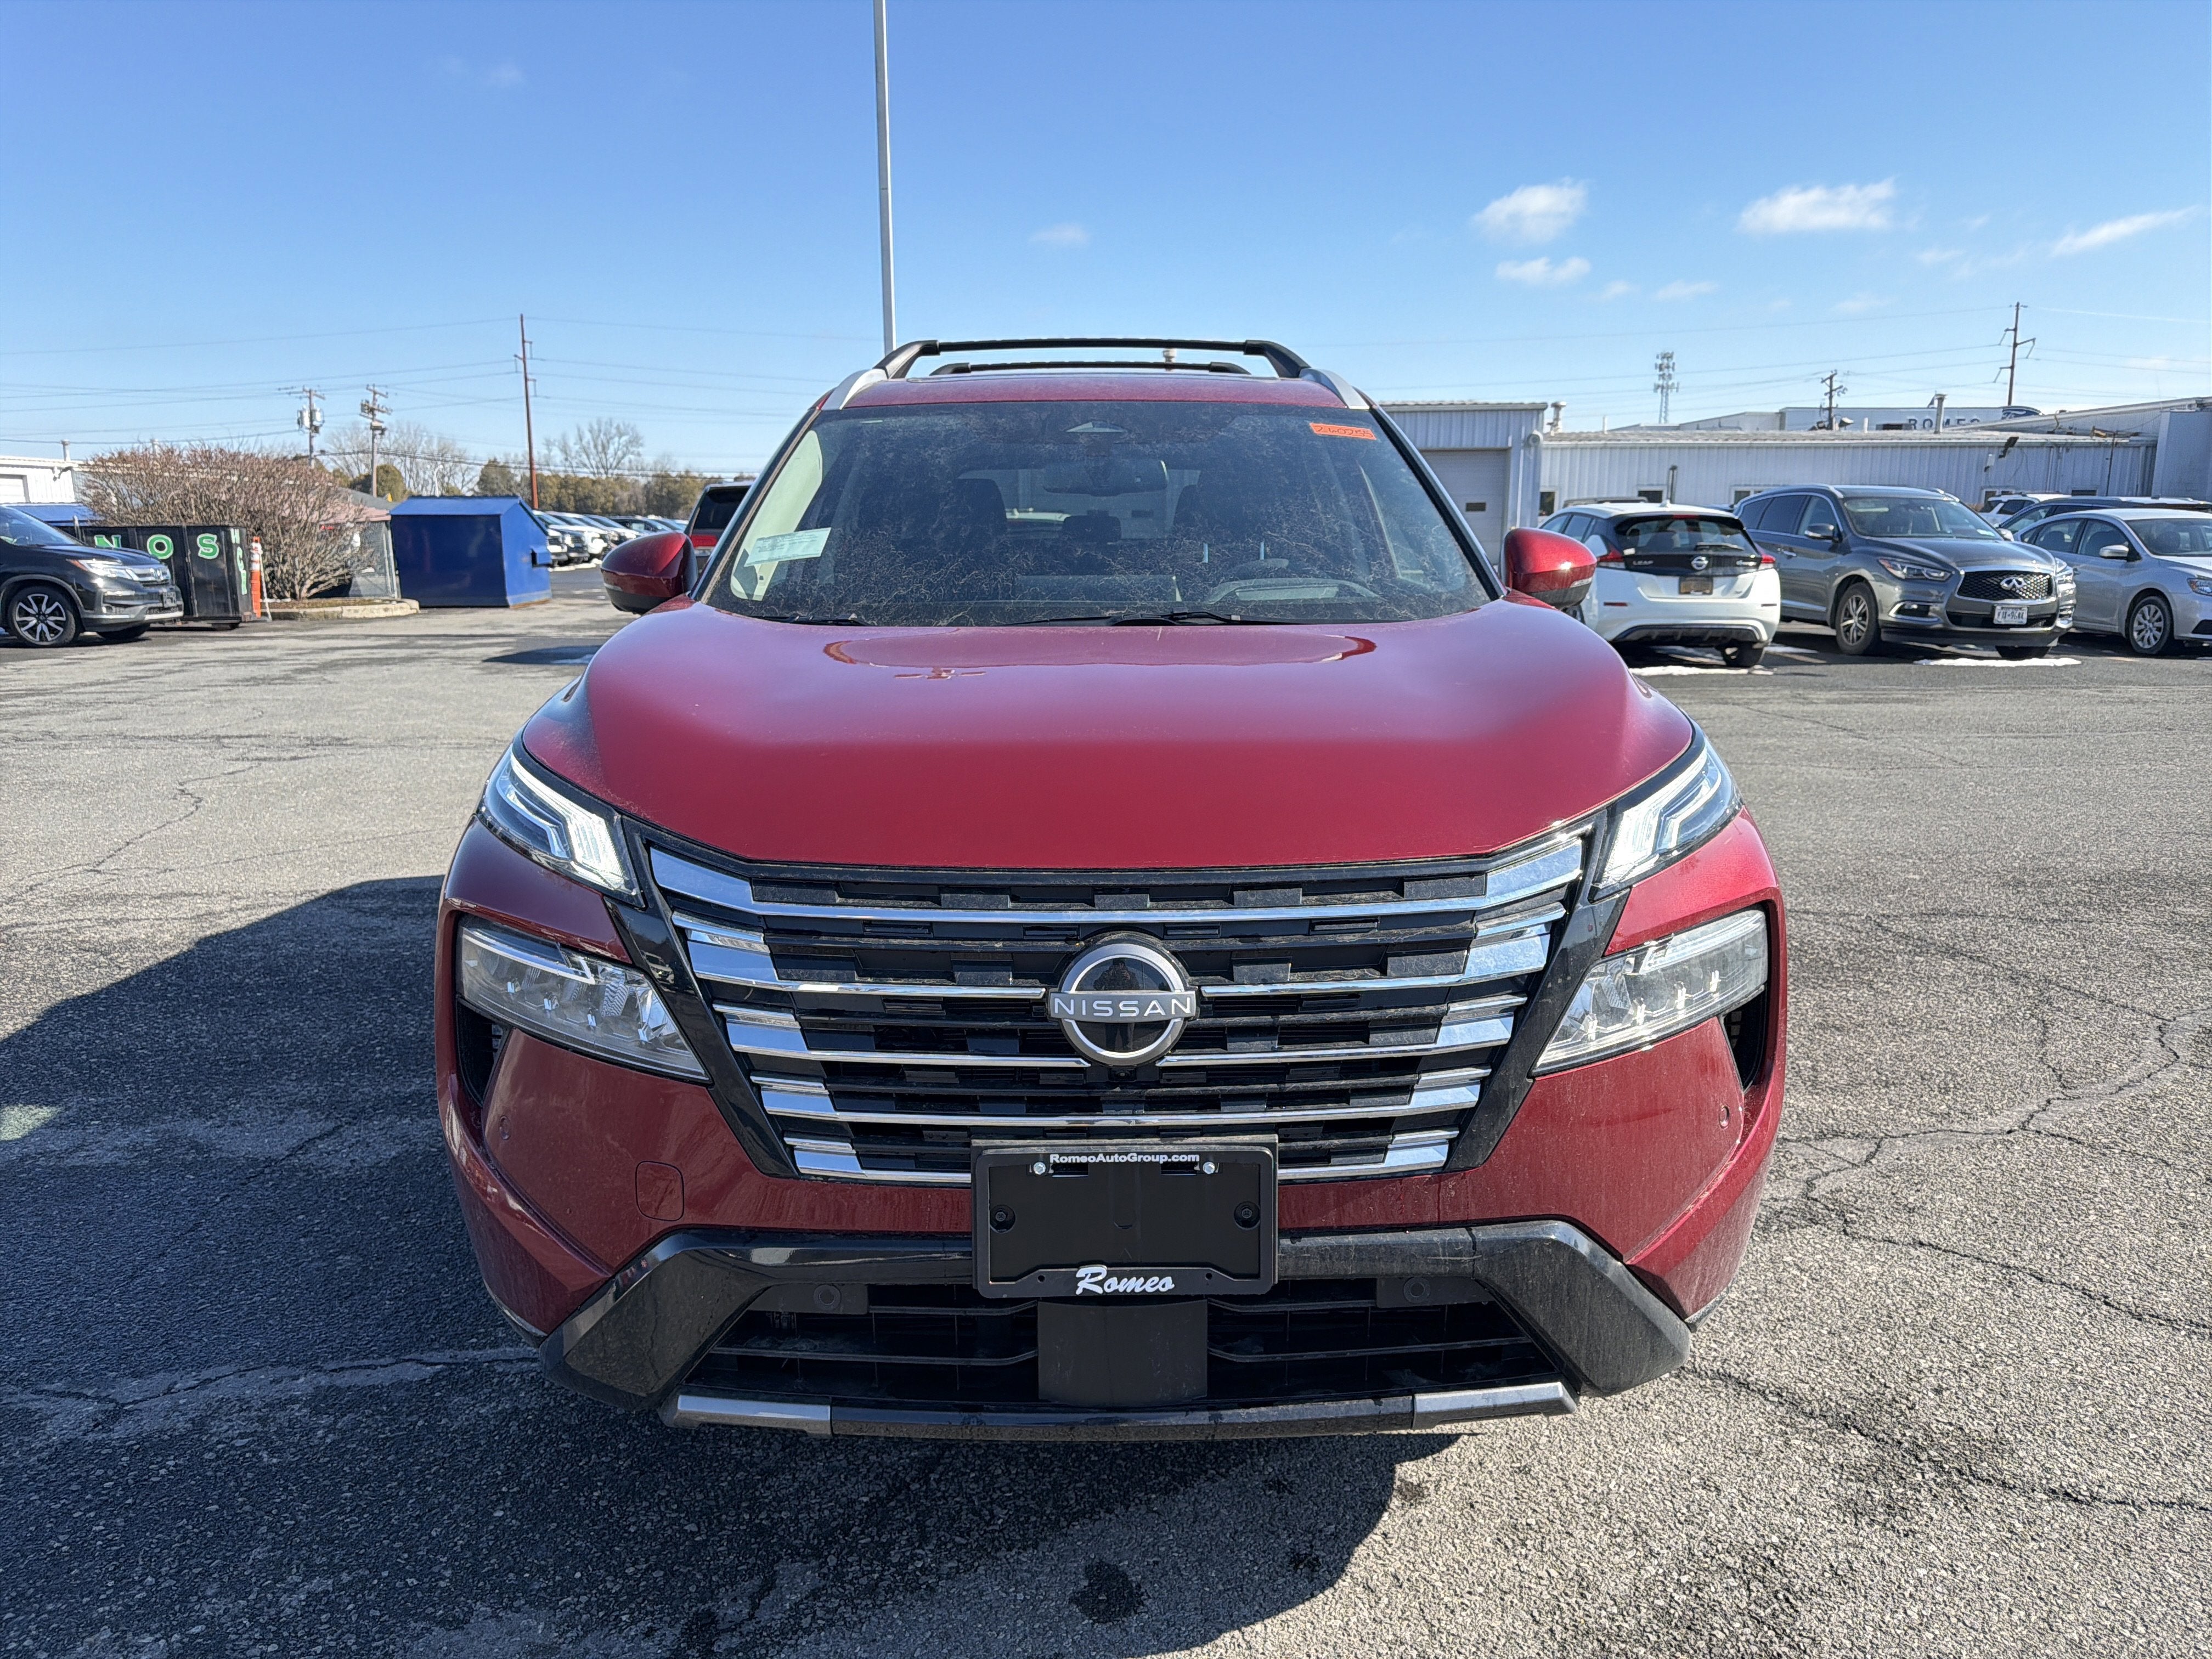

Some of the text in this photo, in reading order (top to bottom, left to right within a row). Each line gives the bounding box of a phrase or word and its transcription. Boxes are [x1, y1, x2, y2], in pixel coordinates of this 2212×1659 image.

[1054, 997, 1191, 1017] NISSAN
[1050, 1153, 1200, 1163] RomeoAutoGroup.com
[1076, 1266, 1175, 1295] Romeo
